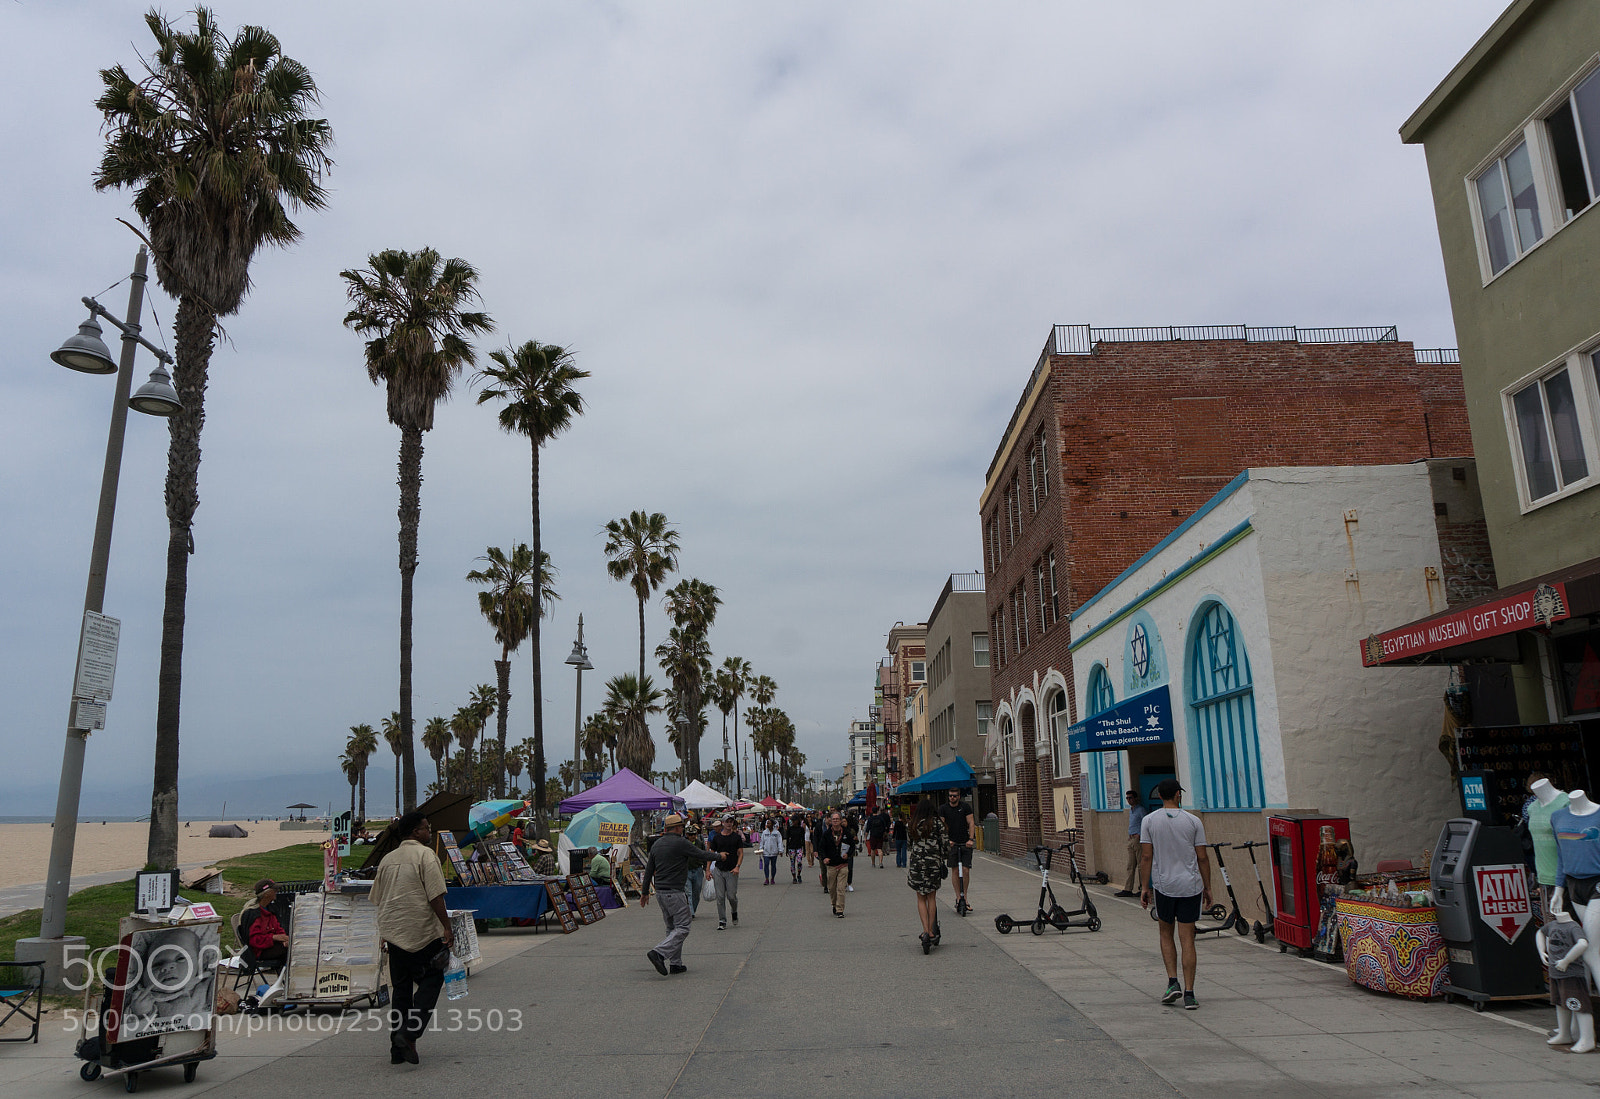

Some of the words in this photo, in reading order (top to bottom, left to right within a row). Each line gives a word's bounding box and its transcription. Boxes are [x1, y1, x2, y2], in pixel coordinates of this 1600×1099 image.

[1383, 632, 1426, 655] EGYPTIAN
[1428, 619, 1468, 643] MUSEUM
[1473, 609, 1498, 631] GIFT
[1500, 601, 1531, 625] SHOP
[1115, 717, 1132, 725] Shul
[1105, 728, 1118, 736] the
[1101, 735, 1160, 745] www.pjcenter.com
[1464, 783, 1485, 795] ATM
[600, 823, 628, 831] HEALER
[1482, 872, 1526, 901] ATM
[1484, 900, 1528, 914] HERE
[330, 972, 338, 981] TV
[340, 985, 348, 993] you
